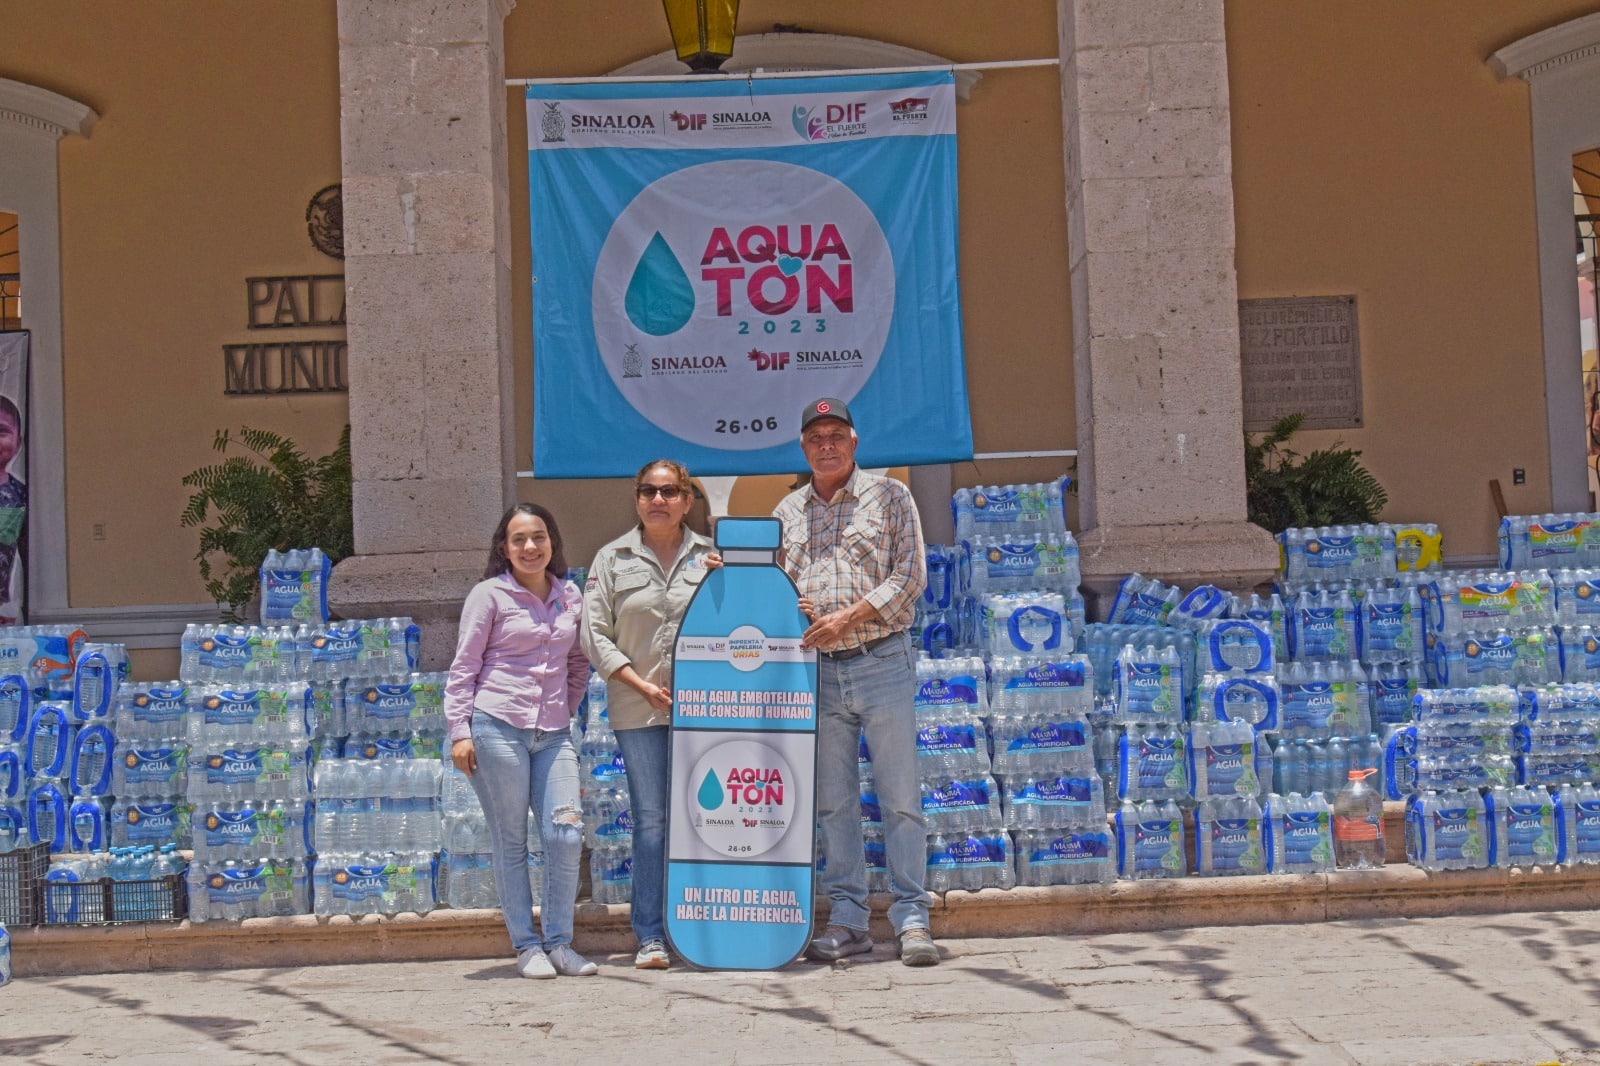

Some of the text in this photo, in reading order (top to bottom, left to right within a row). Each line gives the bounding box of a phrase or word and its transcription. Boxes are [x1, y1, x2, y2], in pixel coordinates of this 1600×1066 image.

[712, 111, 771, 123] SINALOA
[826, 103, 867, 124] DIF
[902, 113, 928, 121] FUERTE
[571, 114, 655, 129] SINALOA
[677, 113, 707, 131] DIF
[827, 123, 867, 133] EL FUERTE
[700, 224, 852, 265] AQUA
[246, 274, 346, 329] PAL
[738, 318, 826, 335] 2023
[796, 349, 863, 363] SINALOA
[651, 356, 727, 371] SINALOA
[756, 352, 790, 371] DIF
[989, 503, 1017, 513] AGUA
[1546, 534, 1577, 545] AGUA
[1323, 549, 1352, 558] AGUA
[1005, 557, 1034, 566] AGUA
[274, 585, 300, 594] AGUA
[1479, 597, 1511, 607] AGUA
[1134, 608, 1157, 619] AGUA
[1310, 623, 1334, 631] AGUA
[1377, 618, 1401, 626] AGUA
[328, 640, 358, 651] AGUA
[215, 648, 247, 658] AGUA
[1481, 648, 1512, 659] AGUA
[1135, 679, 1160, 688] AGUA
[379, 697, 410, 707] AGUA
[677, 690, 814, 705] DONA AGUA EMBOTELLADA
[928, 697, 964, 705] PURIFICADA
[1307, 697, 1332, 706] AGUA
[1384, 694, 1408, 702] AGUA
[150, 702, 181, 712] AGUA
[221, 703, 254, 714] AGUA
[679, 704, 812, 719] PARA CONSUMO HUMANO
[1148, 753, 1173, 761] AGUA
[140, 762, 170, 772] AGUA
[224, 761, 257, 773] AGUA
[1216, 760, 1241, 769] AGUA
[727, 768, 783, 784] AQUA
[941, 800, 976, 808] PURIFICADA
[143, 817, 173, 828] AGUA
[1514, 820, 1541, 829] AGUA
[221, 822, 251, 834] AGUA
[1292, 827, 1318, 837] AGUA
[1442, 824, 1467, 834] AGUA
[1143, 836, 1169, 846] AGUA
[1220, 835, 1246, 844] AGUA
[227, 882, 260, 893] AGUA
[350, 879, 383, 890] AGUA
[684, 887, 800, 907] UN LITRO DE AGUA,
[676, 904, 807, 924] HACE LA DIFERENCIA.
